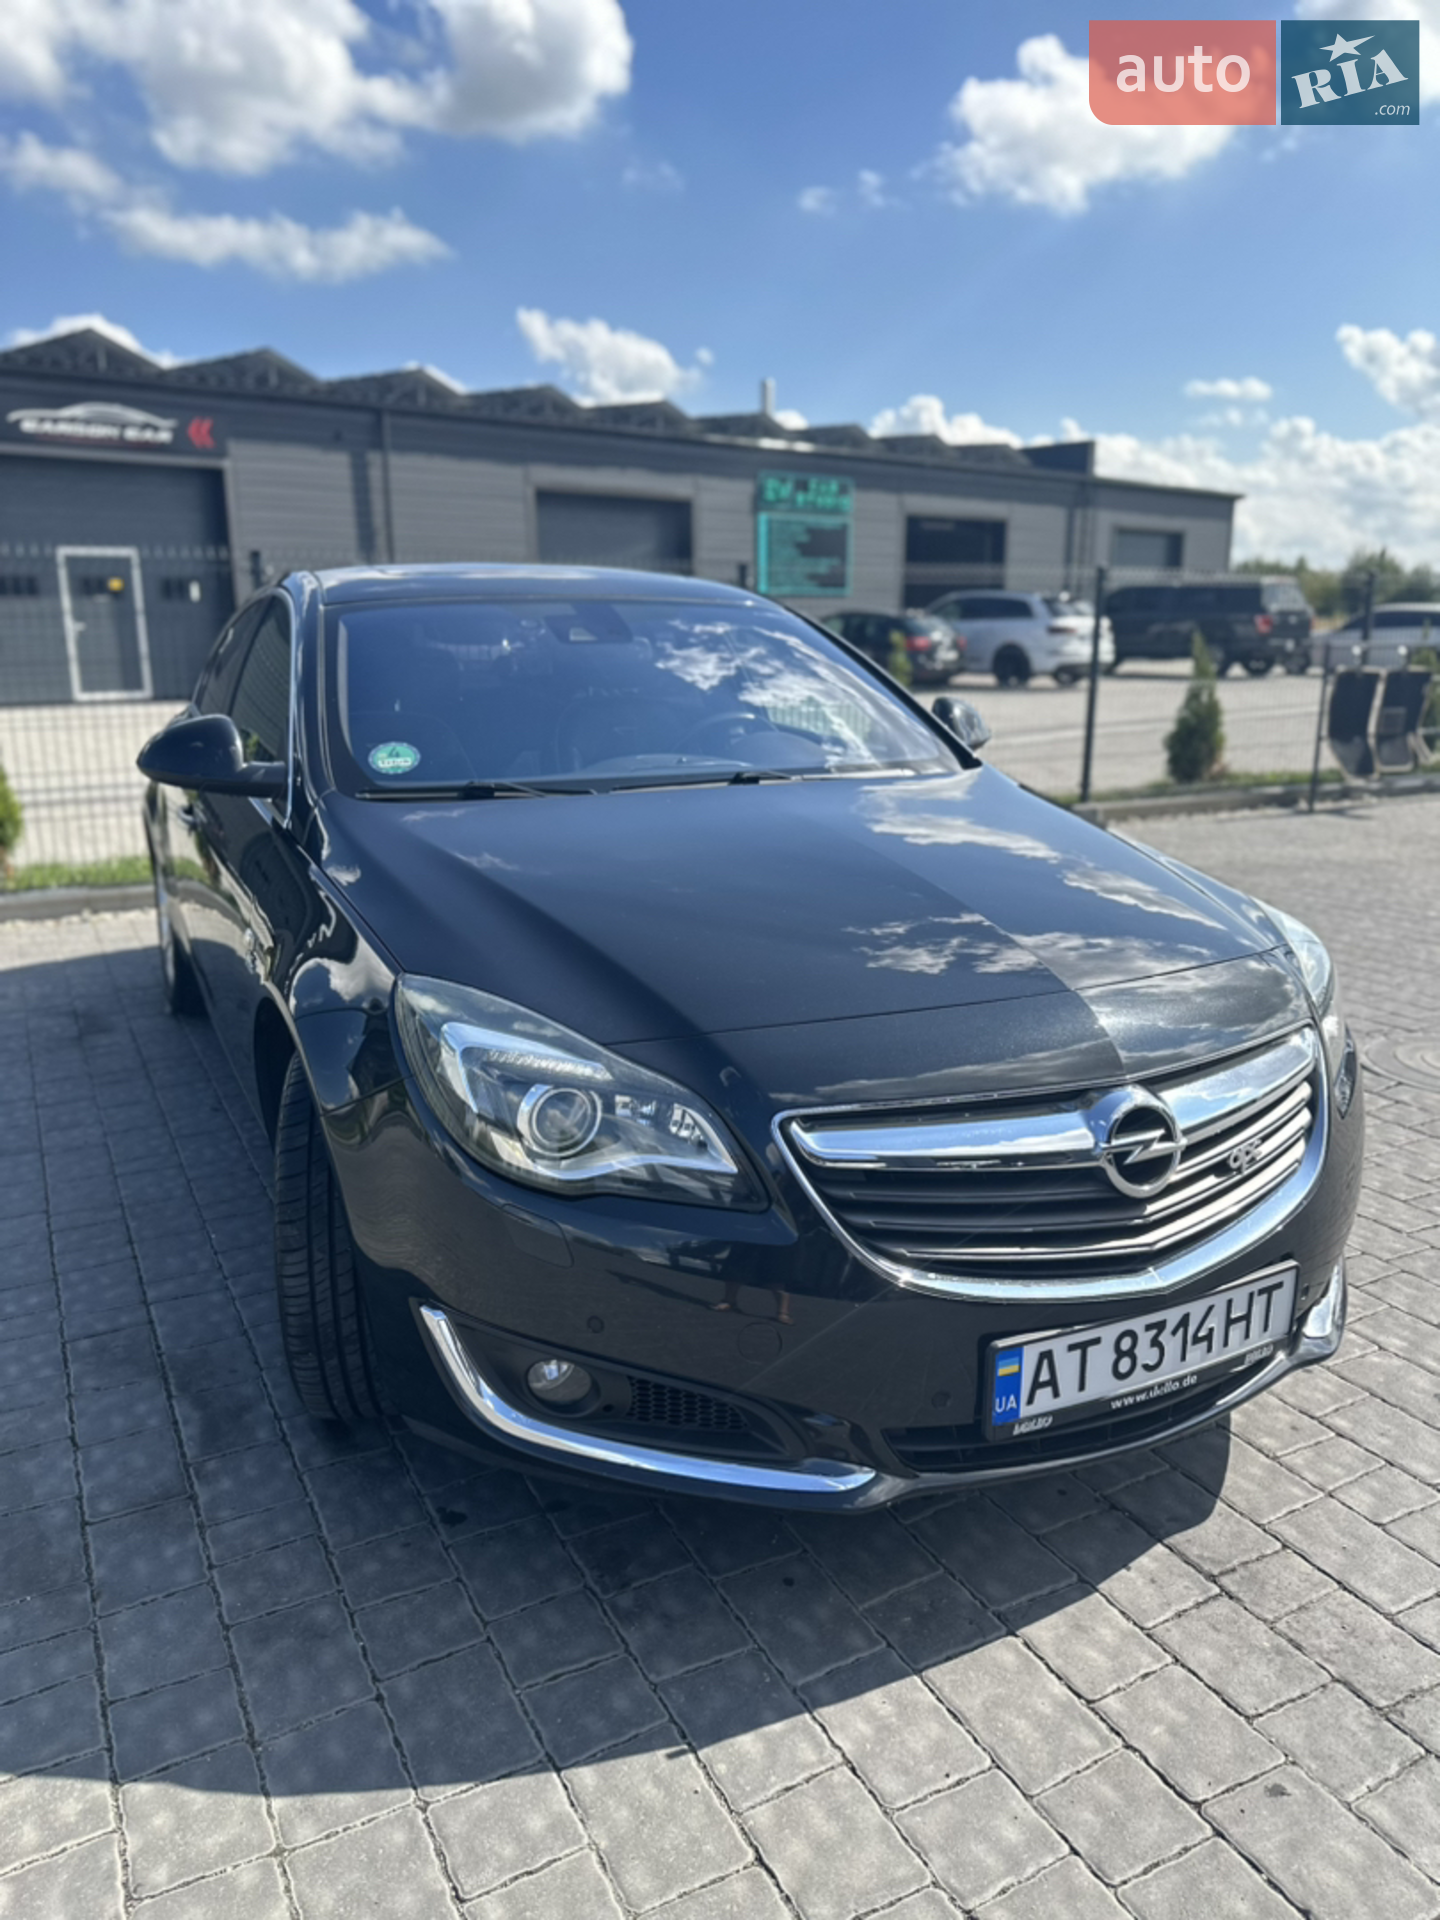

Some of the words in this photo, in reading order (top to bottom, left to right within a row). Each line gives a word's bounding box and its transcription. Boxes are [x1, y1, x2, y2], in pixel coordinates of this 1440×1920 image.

[1026, 1337, 1102, 1406] AT
[1111, 1304, 1215, 1382] 8314
[1222, 1281, 1284, 1348] HT
[994, 1394, 1018, 1413] UA
